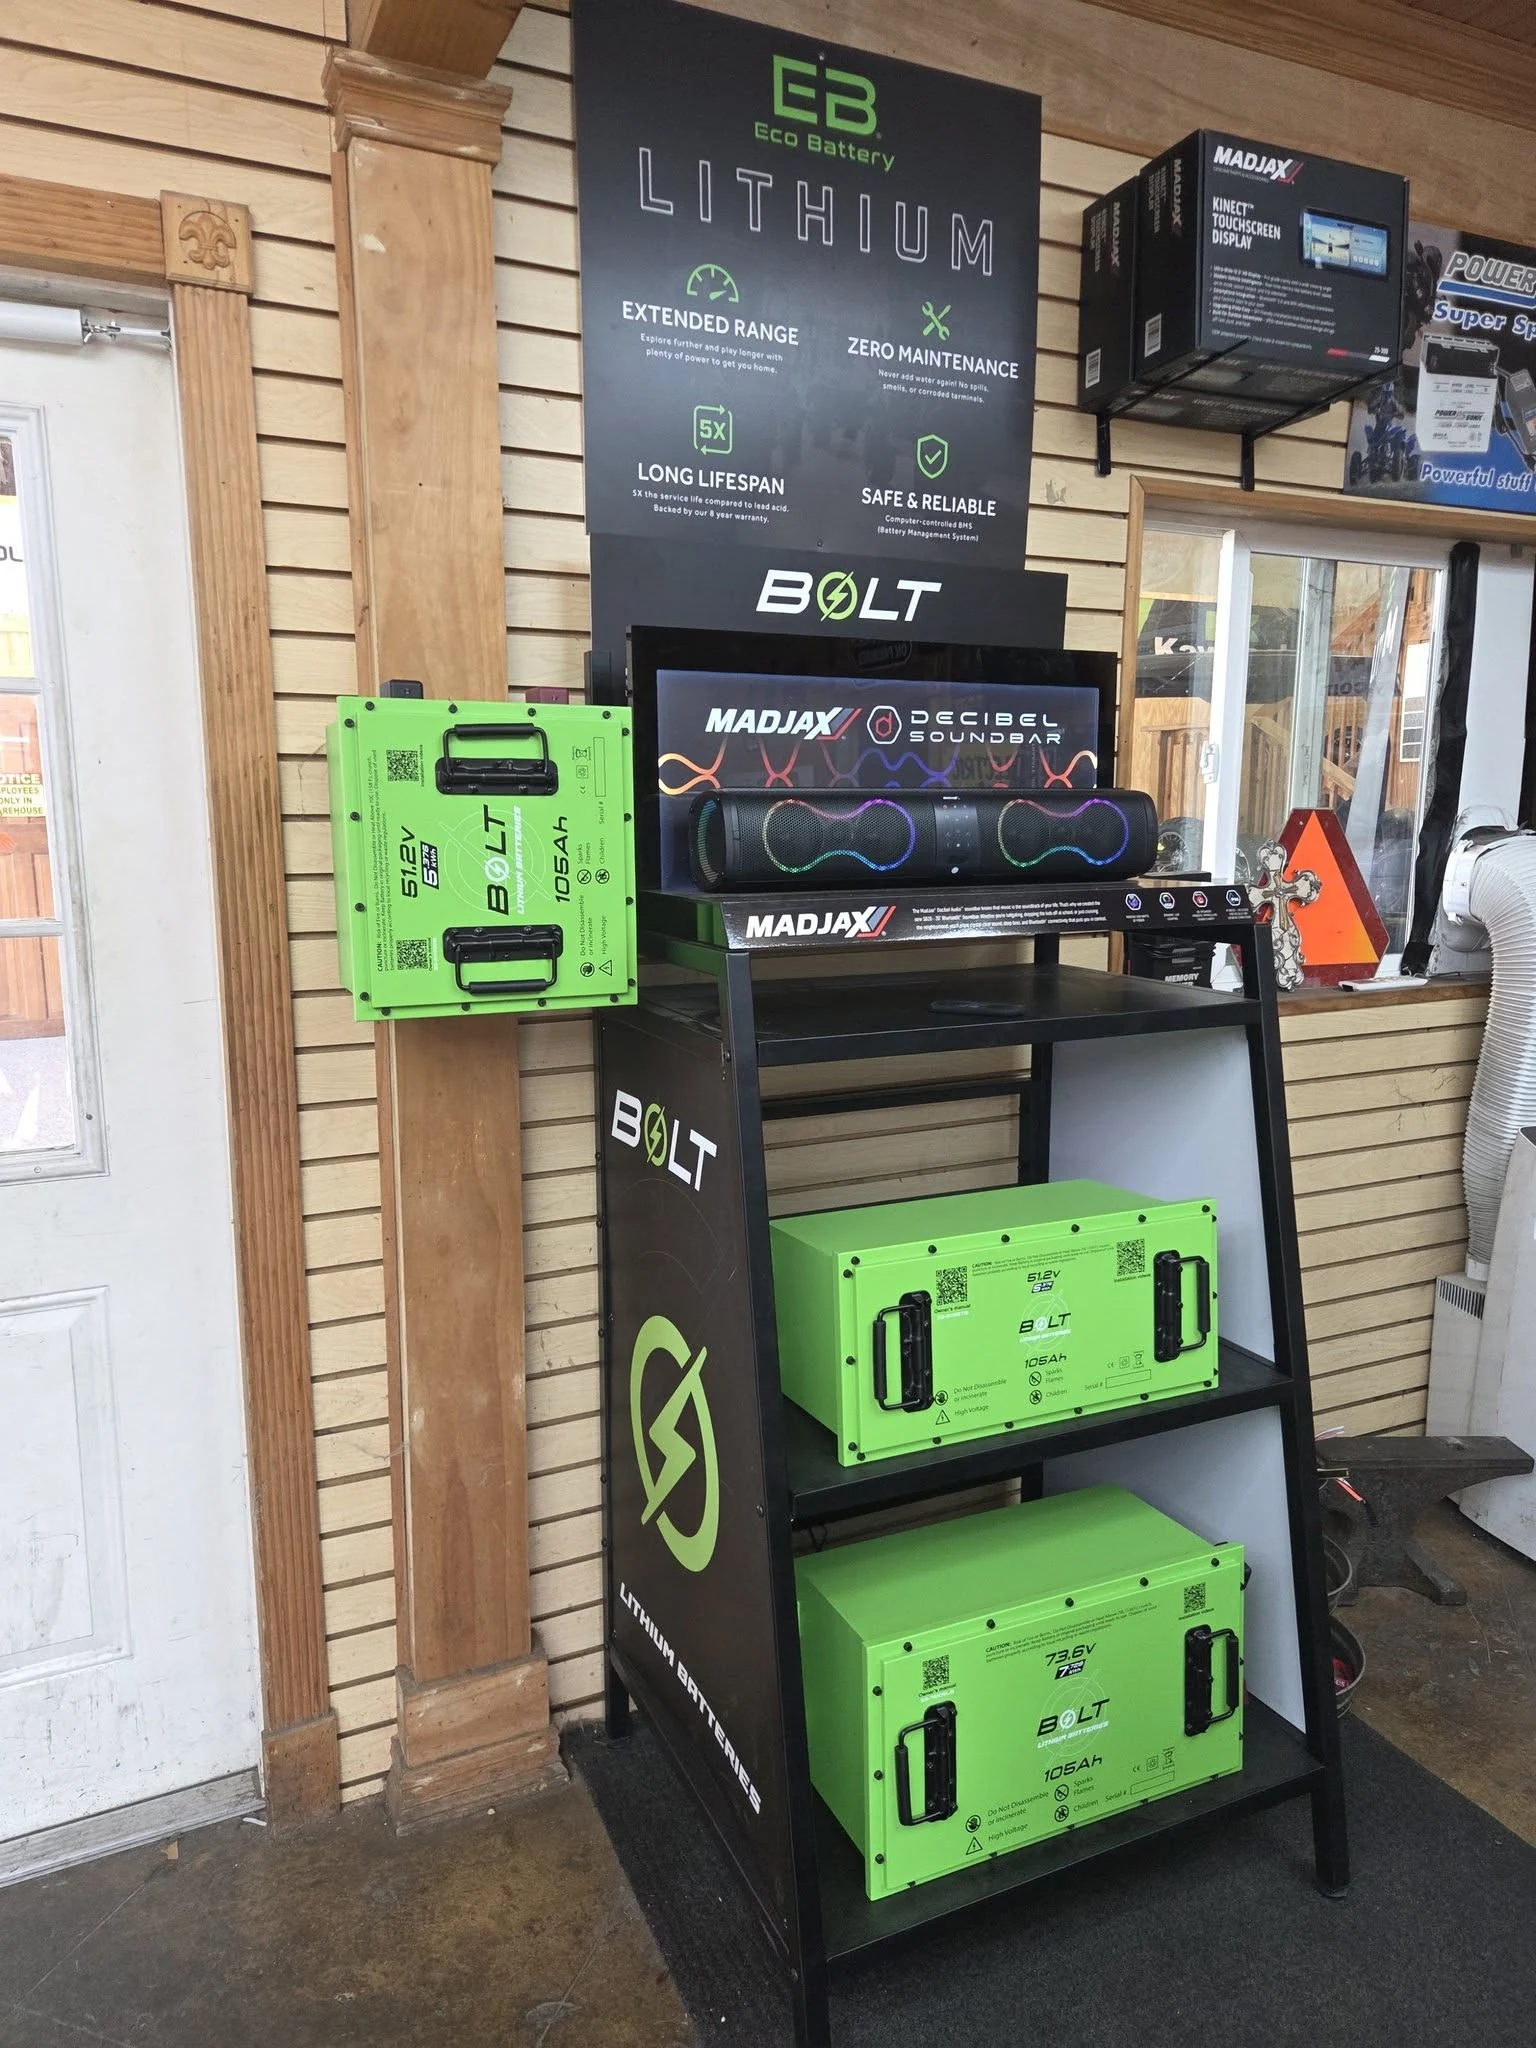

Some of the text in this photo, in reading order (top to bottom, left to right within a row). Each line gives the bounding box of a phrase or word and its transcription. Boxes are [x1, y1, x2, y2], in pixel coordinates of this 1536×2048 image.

[773, 55, 877, 136] EB
[754, 122, 895, 172] Eco Battery
[1213, 145, 1294, 180] MADJAX
[1172, 158, 1182, 227] MADJAX
[639, 147, 993, 277] LITHIUM
[1110, 201, 1120, 268] MADJAX
[1212, 213, 1281, 240] TOUCHSCREEN
[1212, 229, 1252, 250] DISPLAY
[1444, 251, 1536, 293] POWER
[622, 301, 799, 345] EXTENDED RANGE
[1432, 301, 1508, 330] Super
[640, 333, 783, 362] Explore further and play longer with
[847, 336, 1019, 379] ZERO MAINTENANCE
[646, 348, 778, 374] plenty of power to get you home.
[878, 369, 899, 380] Never
[901, 372, 914, 381] add
[915, 375, 935, 385] water
[936, 378, 957, 389] again!
[958, 381, 969, 389] No
[882, 383, 908, 393] smells,
[918, 388, 950, 399] corroded
[951, 391, 985, 404] terminals.
[699, 419, 726, 441] 5X
[638, 462, 785, 495] LONG LIFESPAN
[1420, 463, 1530, 494] Powerful stuff
[632, 489, 789, 512] 5X the service life compared to lead acid.
[861, 487, 997, 517] SAFE & RELIABLE
[653, 504, 682, 514] Backed
[683, 506, 693, 516] by
[694, 509, 708, 517] our
[716, 512, 733, 520] year
[734, 512, 770, 524] warranty.
[885, 515, 973, 530] Computer-controlled BMS
[877, 526, 979, 542] (Battery Management System)
[756, 569, 942, 622] BOLT
[704, 706, 1058, 740] MADJAX DECIBEL
[910, 731, 1061, 744] SOUNDBAR
[483, 803, 509, 916] BOLT
[553, 816, 570, 903] 105Ah
[576, 843, 584, 864] Sparks
[598, 837, 606, 865] Children
[578, 894, 586, 933] Disassemble
[745, 906, 881, 939] MADJAX
[579, 946, 586, 956] Do
[588, 948, 594, 956] or
[600, 939, 608, 955] High
[1164, 973, 1199, 983] MEMORY
[611, 1089, 718, 1192] BOLT
[1018, 1312, 1071, 1334] BOLT
[1024, 1353, 1067, 1369] 105Ah
[963, 1384, 973, 1392] Not
[974, 1379, 1007, 1391] Disassemble
[1045, 1388, 1068, 1398] Children
[954, 1405, 989, 1417] High Voltage
[619, 1581, 762, 1815] LITHIUM BATTERIES
[1037, 1698, 1110, 1737] BOLT
[1044, 1754, 1103, 1783] 105Ah
[1073, 1776, 1094, 1788] Sparks
[1073, 1785, 1095, 1797] Flames
[987, 1791, 1050, 1817] Do Not Disassemble
[1073, 1799, 1099, 1812] Children
[1105, 1791, 1123, 1801] Serial
[996, 1807, 1027, 1824] incinerate
[988, 1823, 1029, 1841] High Voltage
